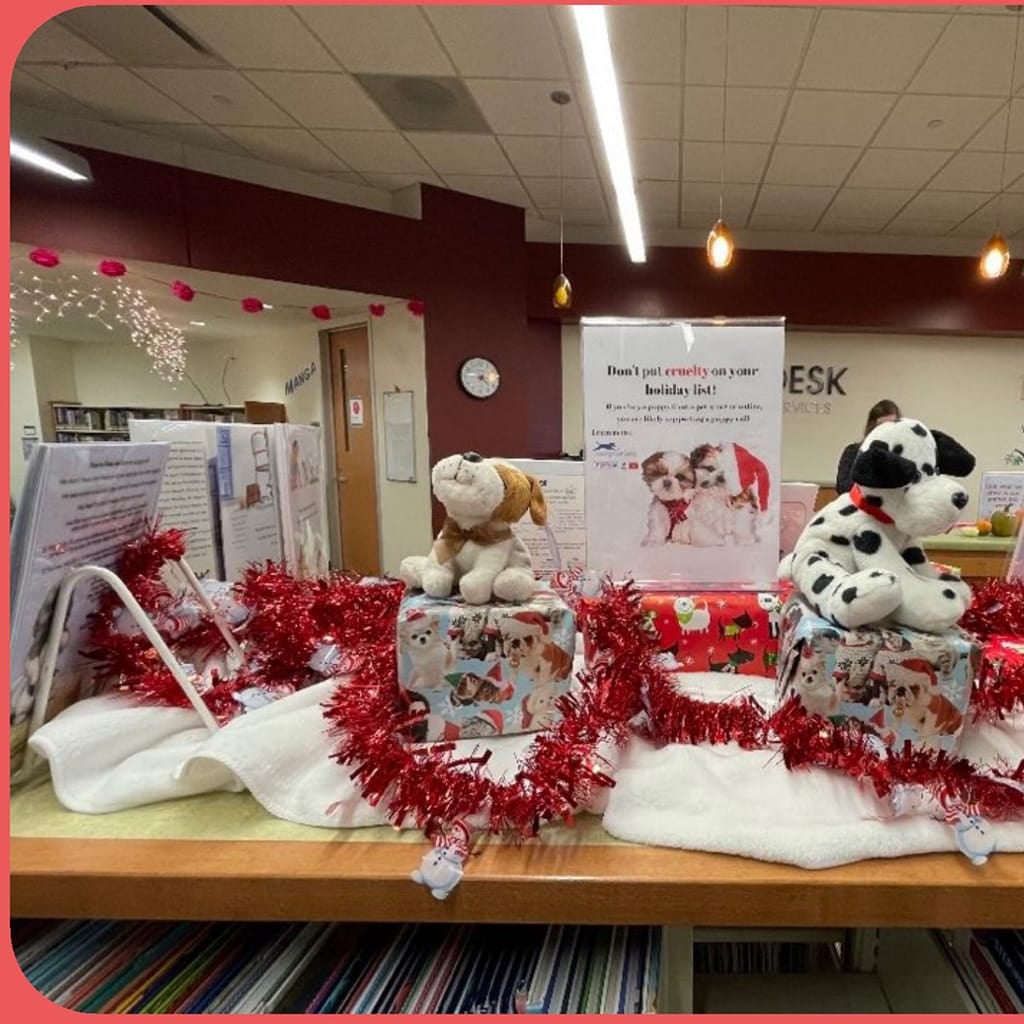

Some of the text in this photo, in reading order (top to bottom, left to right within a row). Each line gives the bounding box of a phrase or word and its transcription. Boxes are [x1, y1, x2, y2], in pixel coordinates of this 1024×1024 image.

[607, 364, 759, 379] Don't put cruelty on your
[783, 365, 848, 395] ESK
[645, 383, 717, 398] holiday list!
